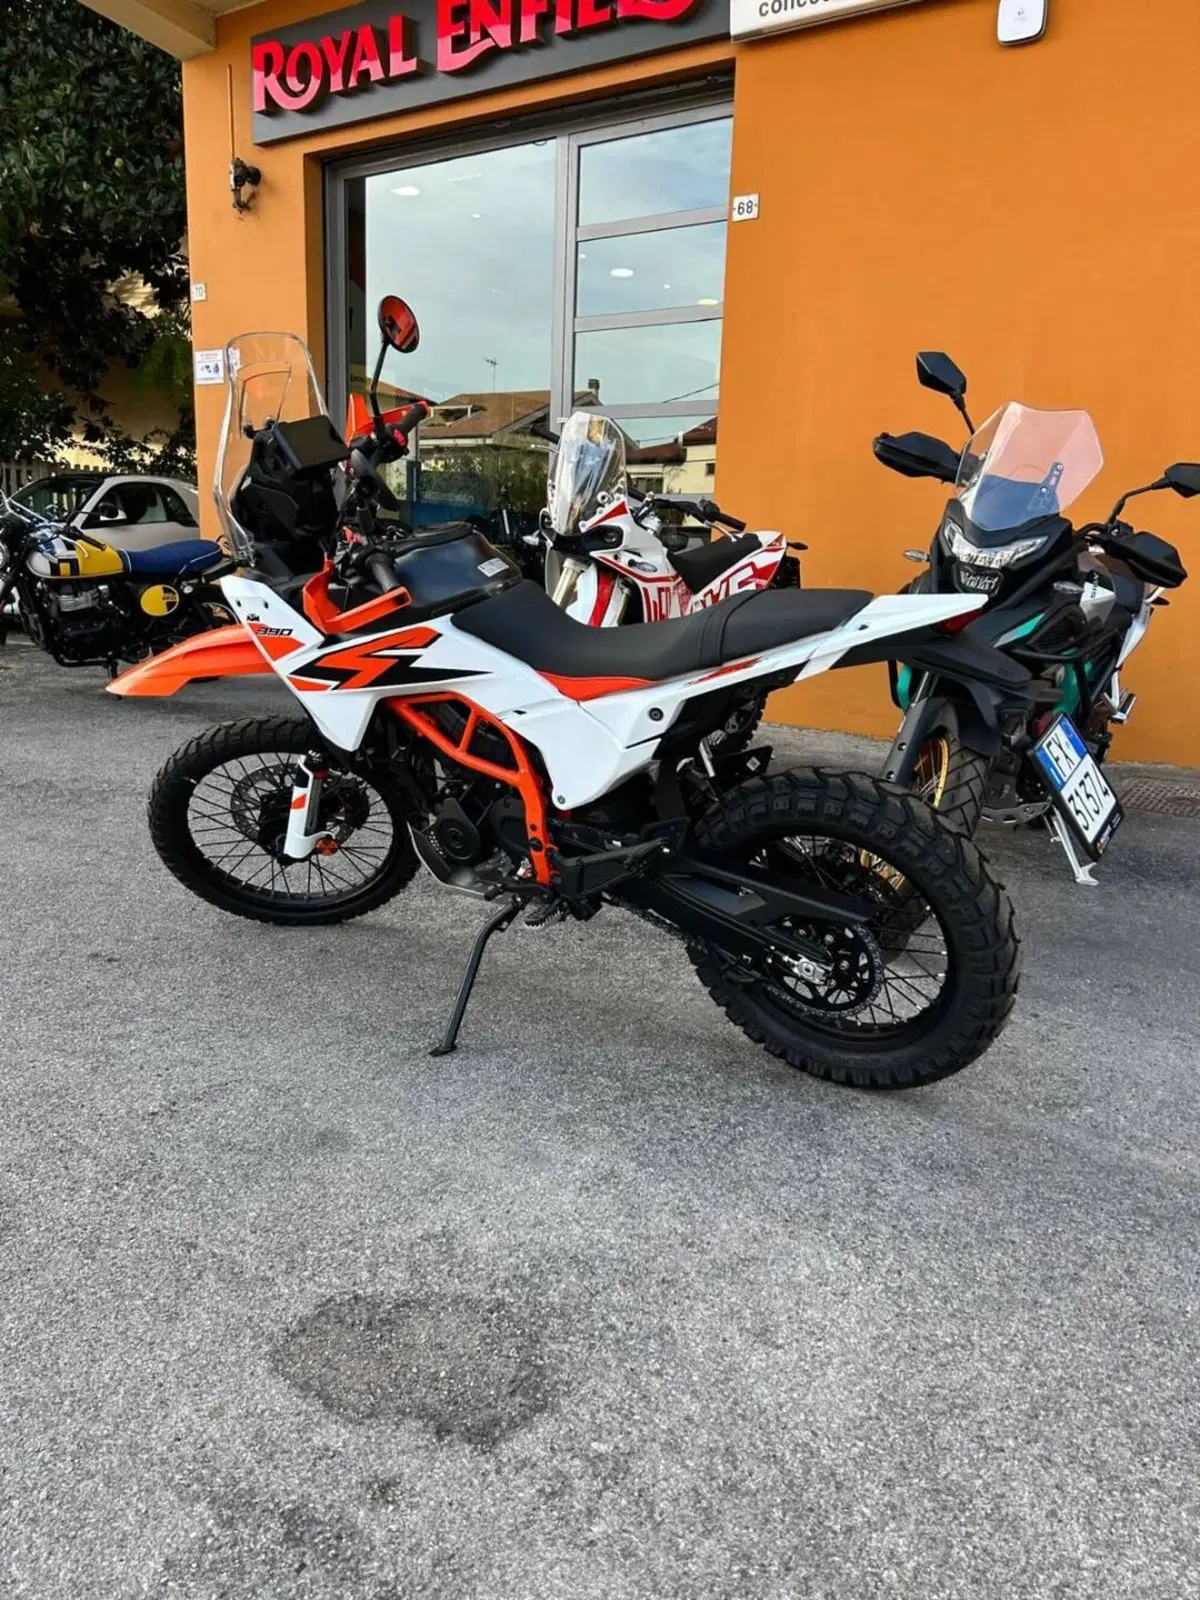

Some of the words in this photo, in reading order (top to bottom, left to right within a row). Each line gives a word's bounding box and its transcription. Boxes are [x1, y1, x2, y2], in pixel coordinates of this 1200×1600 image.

[252, 14, 417, 112] ROYAL
[437, 0, 697, 72] ENFI
[737, 200, 753, 215] 68
[257, 627, 293, 636] 390
[1046, 732, 1075, 778] FX
[1068, 763, 1110, 831] 31374
